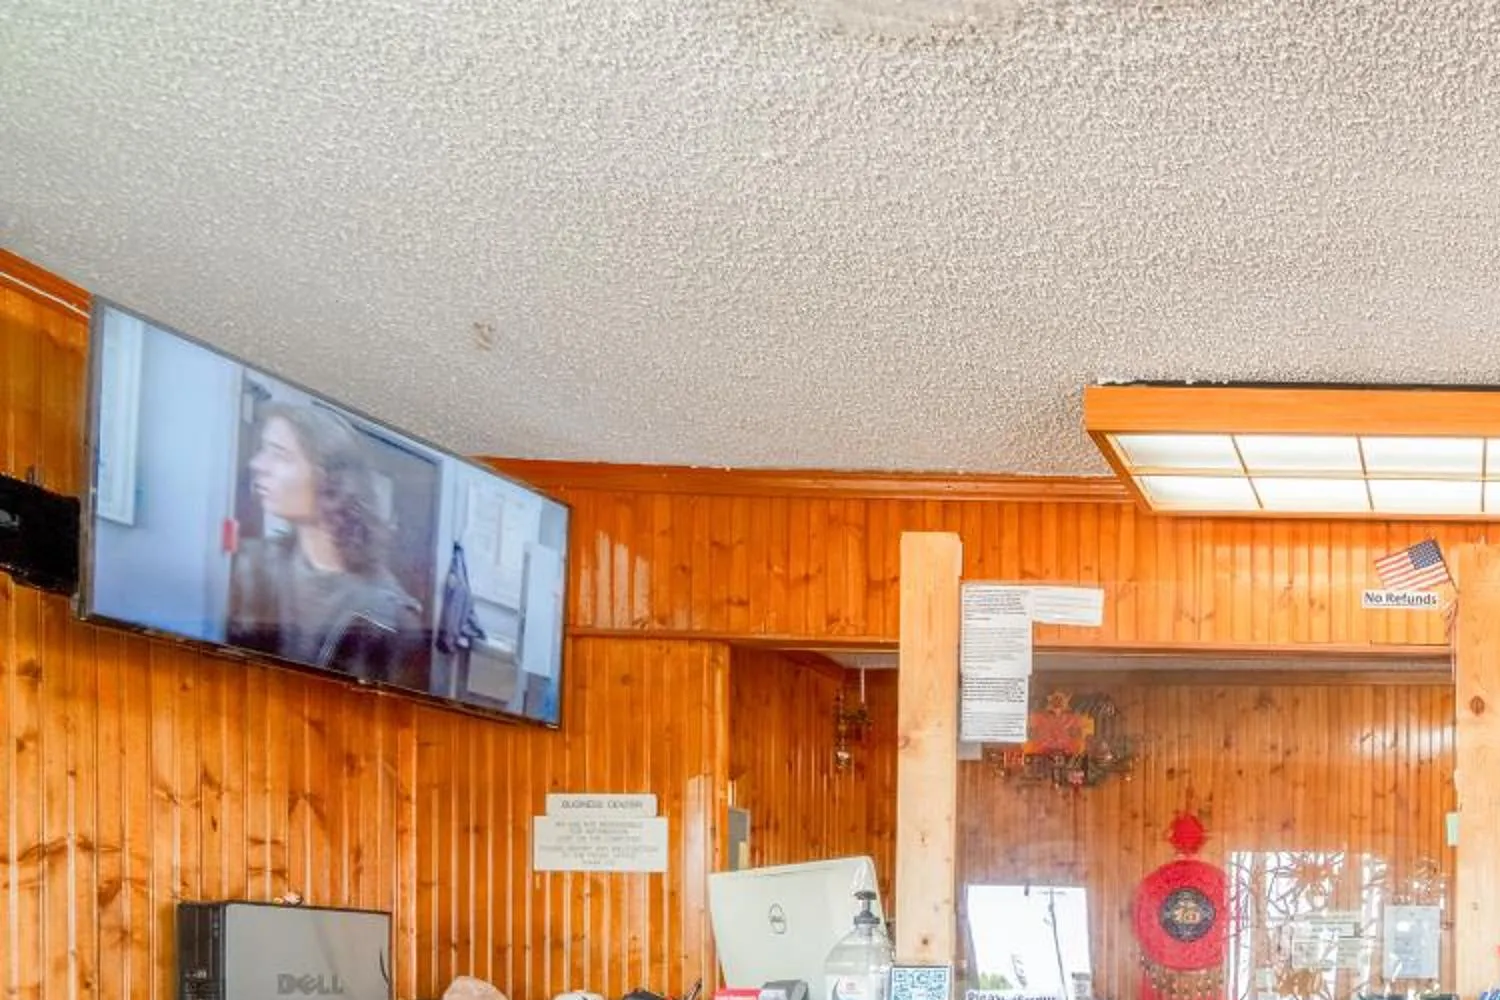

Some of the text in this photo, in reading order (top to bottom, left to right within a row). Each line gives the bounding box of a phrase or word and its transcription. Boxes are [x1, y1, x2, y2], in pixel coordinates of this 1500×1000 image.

[1365, 592, 1437, 605] No Refunds
[276, 973, 345, 995] DELL
